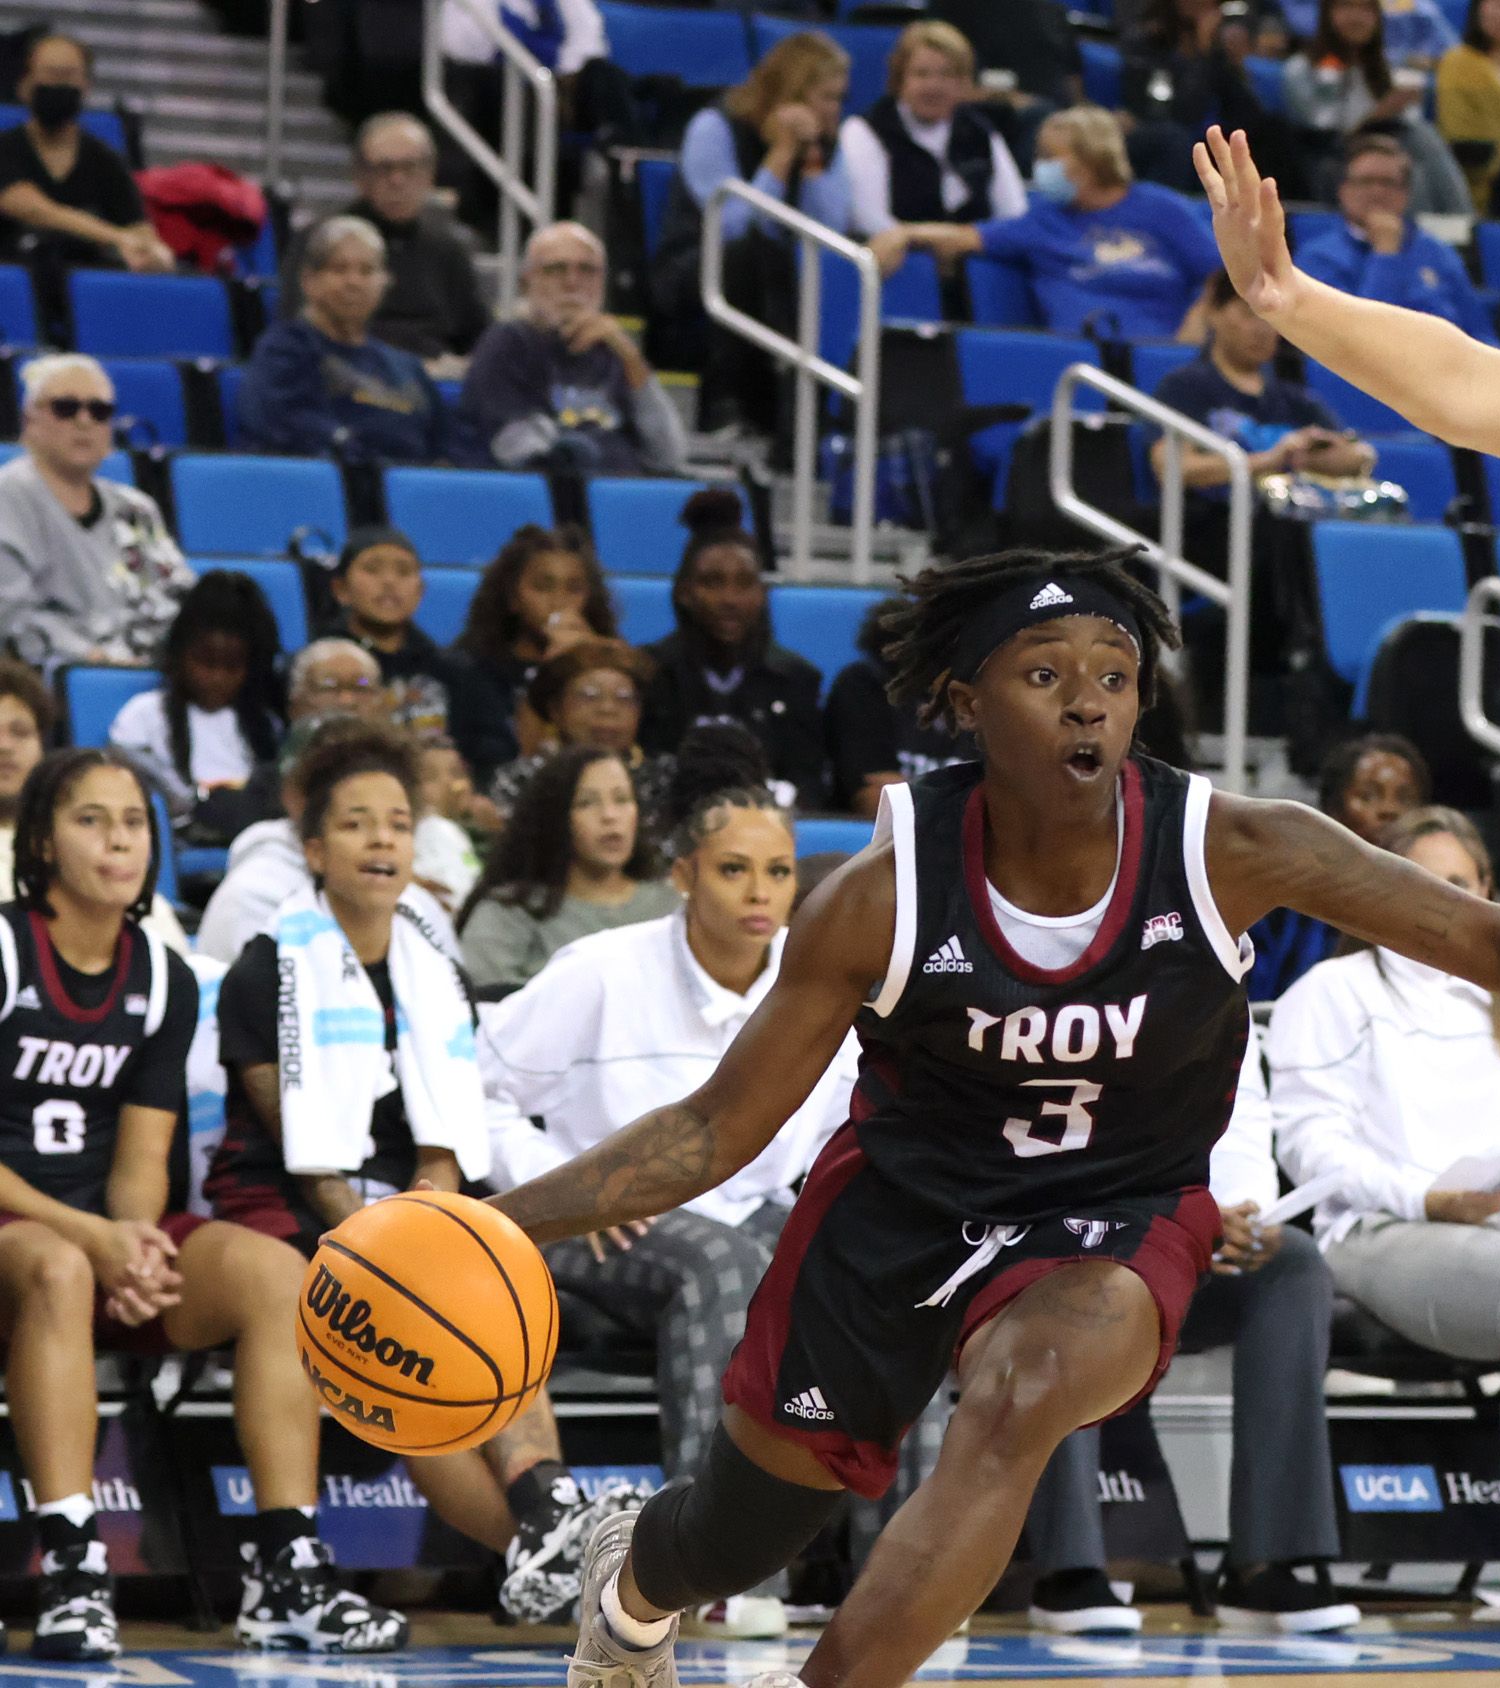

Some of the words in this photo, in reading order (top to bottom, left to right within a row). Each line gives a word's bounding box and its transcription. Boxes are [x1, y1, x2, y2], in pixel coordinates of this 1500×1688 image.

[1030, 594, 1074, 610] adidas
[922, 959, 974, 974] adidas
[966, 994, 1148, 1064] TROY
[12, 1035, 132, 1089] TROY
[32, 1099, 87, 1155] 0
[1002, 1079, 1104, 1158] 3
[307, 1263, 434, 1386] Wilson
[302, 1346, 396, 1433] NCAA
[784, 1402, 835, 1421] adidas
[1356, 1474, 1430, 1500] UCLA
